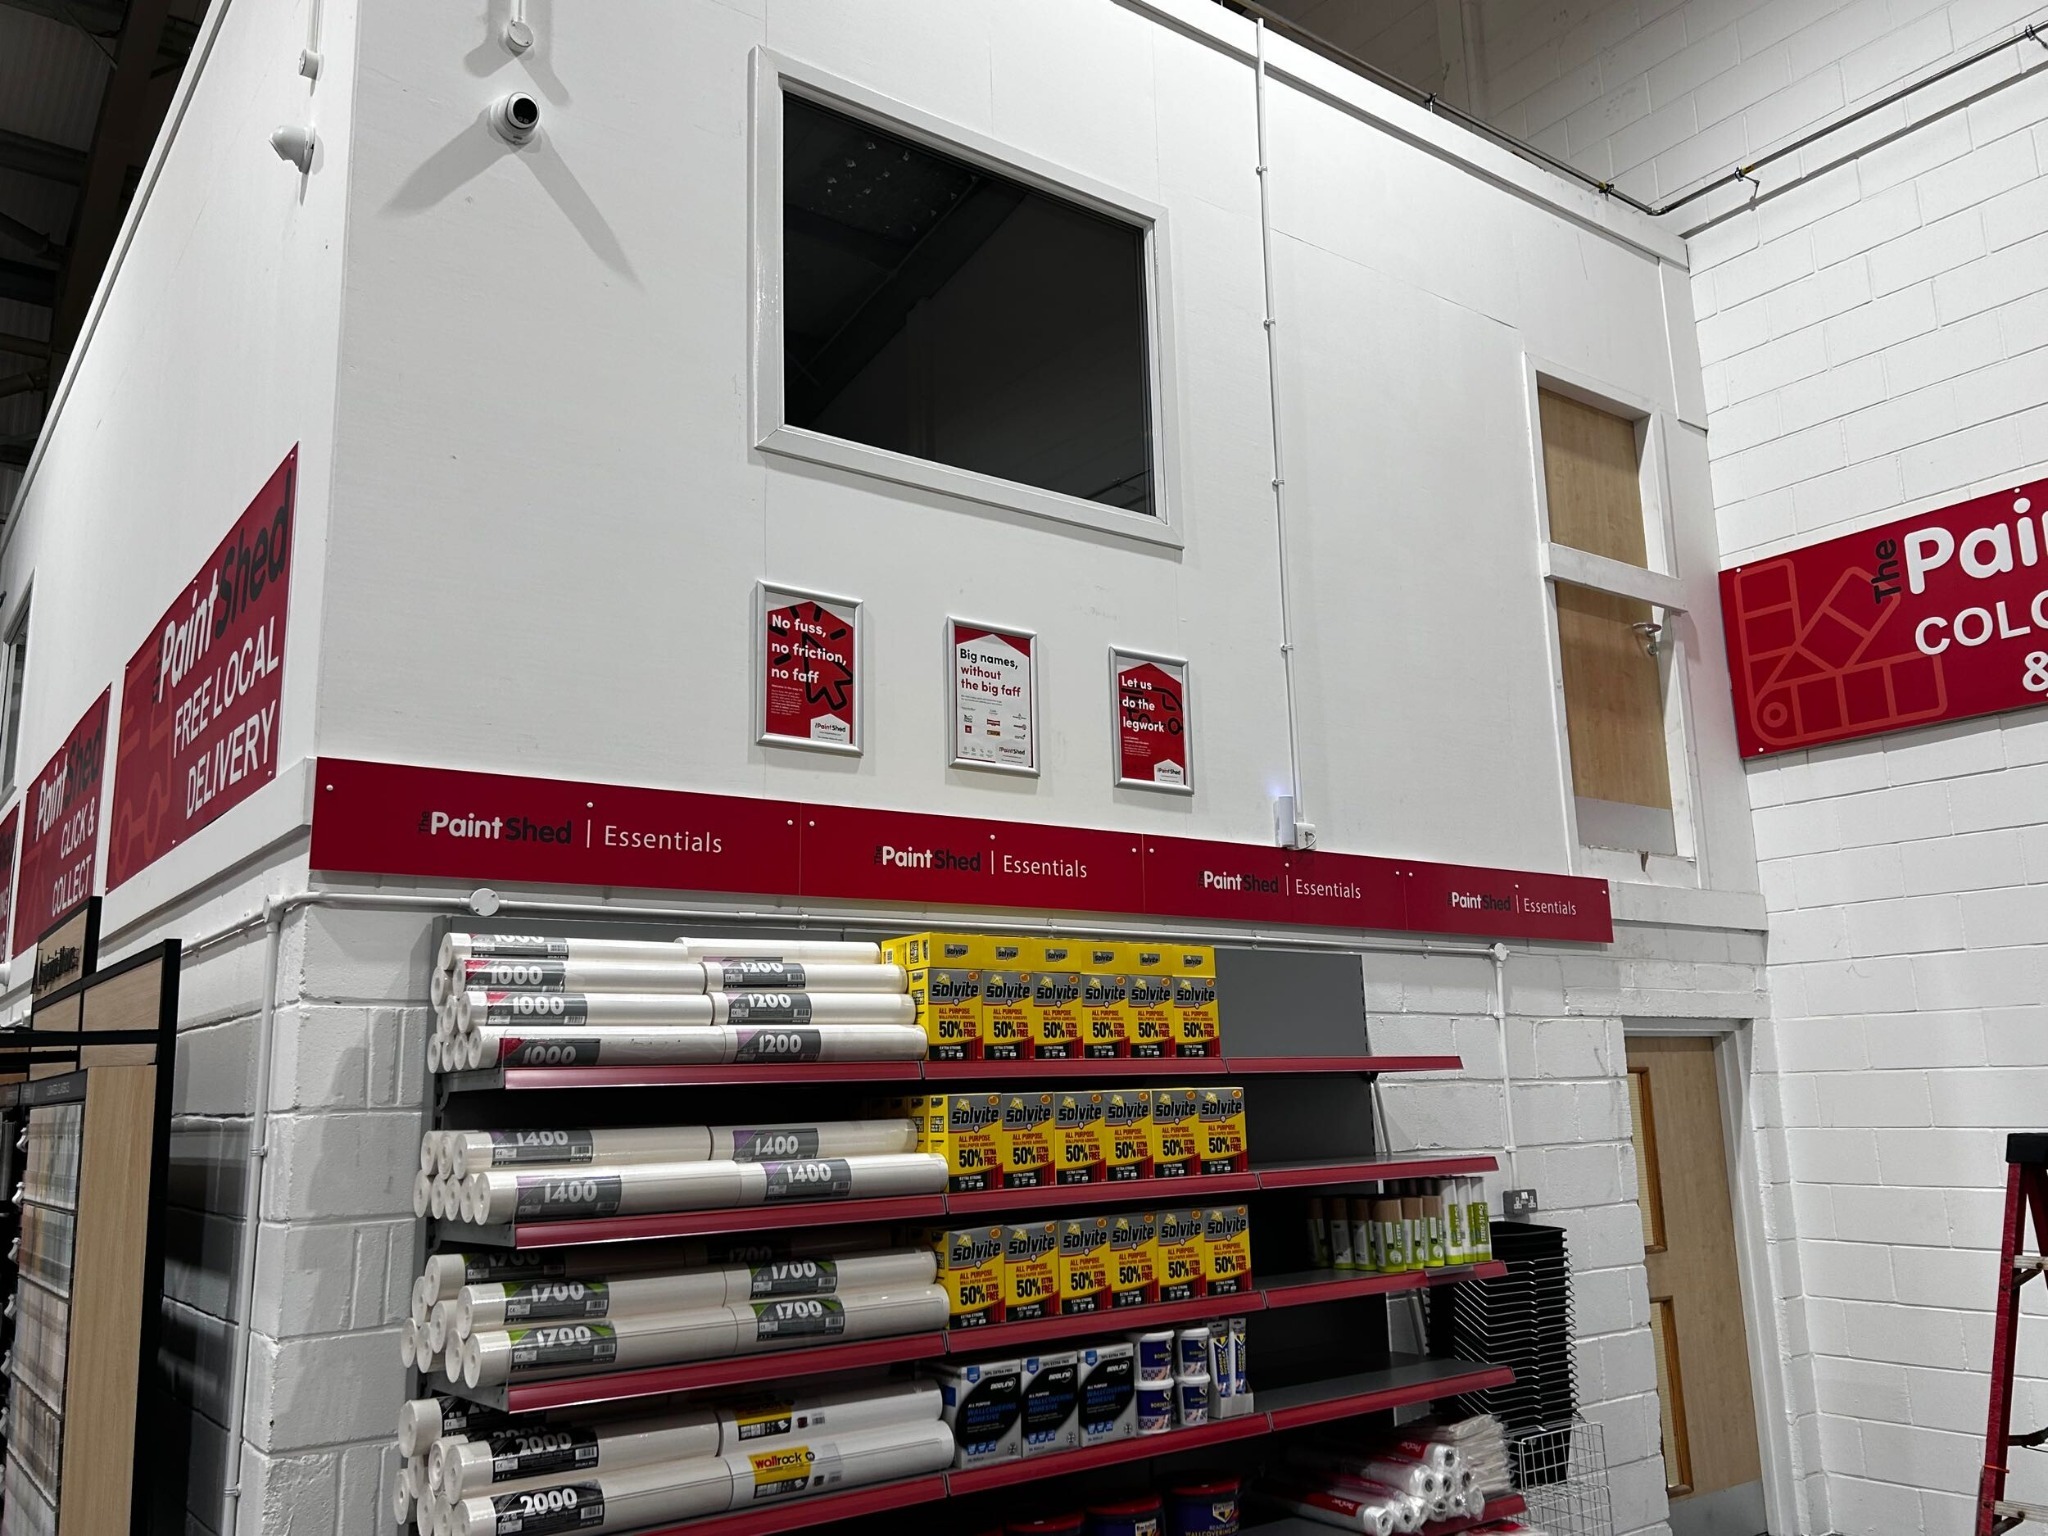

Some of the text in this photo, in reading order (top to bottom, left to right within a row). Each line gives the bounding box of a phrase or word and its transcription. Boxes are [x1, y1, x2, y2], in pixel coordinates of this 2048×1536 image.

[1870, 497, 2048, 604] The Pai
[772, 614, 826, 638] No fuss,
[772, 643, 847, 666] no friction,
[960, 648, 1018, 670] Big names,
[772, 668, 820, 684] no faff
[960, 665, 1002, 680] without
[174, 676, 212, 759] FREE
[213, 616, 279, 719] LOCAL
[960, 678, 1022, 698] the big faff
[1122, 675, 1152, 690] Let us
[1122, 696, 1155, 711] do the
[1123, 716, 1164, 732] legwork
[186, 700, 277, 820] DELIVERY
[60, 803, 88, 859] CLICK
[604, 825, 723, 854] Essentials
[1004, 854, 1088, 879] Essentials
[52, 854, 92, 917] COLLECT
[1296, 878, 1362, 900] Essentials
[1524, 897, 1577, 916] Essentials
[490, 965, 544, 984] 1000
[740, 962, 784, 974] 1200
[932, 982, 978, 997] solvite
[986, 984, 1030, 998] solvite
[1037, 985, 1078, 999] solvite
[1085, 985, 1125, 1000] solvite
[1131, 986, 1170, 1000] solvite
[1177, 987, 1214, 1001] solvite
[512, 996, 565, 1015] 1000
[748, 994, 792, 1008] 1200
[939, 1021, 962, 1038] 50%
[994, 1022, 1015, 1038] 50%
[1043, 1022, 1064, 1038] 50%
[1092, 1022, 1112, 1038] 50%
[1138, 1023, 1158, 1038] 50%
[1183, 1023, 1202, 1038] 50%
[758, 1034, 802, 1054] 1200
[522, 1046, 576, 1064] 1000
[952, 1108, 999, 1124] solvite
[1006, 1106, 1050, 1122] solvite
[1059, 1105, 1101, 1121] solvite
[1108, 1103, 1148, 1118] solvite
[1156, 1102, 1195, 1117] solvite
[1202, 1100, 1241, 1114] solvite
[516, 1130, 568, 1146] 1400
[755, 1136, 798, 1155] 1400
[1208, 1136, 1228, 1153] 50%
[1013, 1146, 1035, 1164] 50%
[1066, 1144, 1087, 1162] 50%
[1115, 1141, 1135, 1159] 50%
[1162, 1139, 1182, 1156] 50%
[959, 1148, 982, 1167] 50%
[984, 1156, 997, 1164] FREE
[1037, 1154, 1049, 1162] FREE
[786, 1163, 832, 1182] 1400
[543, 1180, 598, 1203] 1400
[1112, 1225, 1154, 1243] solvite
[1161, 1221, 1201, 1238] solvite
[1207, 1218, 1246, 1234] solvite
[1009, 1235, 1055, 1254] solvite
[1063, 1230, 1107, 1248] solvite
[953, 1241, 1001, 1261] solvite
[771, 1262, 817, 1279] 1700
[970, 1268, 992, 1278] PURPOSE
[1026, 1262, 1047, 1271] PURPOSE
[1168, 1260, 1188, 1279] 50%
[1214, 1255, 1234, 1273] 50%
[1071, 1271, 1093, 1290] 50%
[1119, 1265, 1140, 1284] 50%
[531, 1284, 585, 1302] 1700
[960, 1284, 984, 1305] 50%
[986, 1290, 999, 1300] FREE
[1016, 1277, 1039, 1297] 50%
[1041, 1283, 1054, 1293] FREE
[776, 1301, 823, 1319] 1700
[536, 1326, 592, 1348] 1700
[515, 1432, 572, 1456] 2000
[755, 1452, 802, 1469] wallrock
[520, 1488, 578, 1517] 2000
